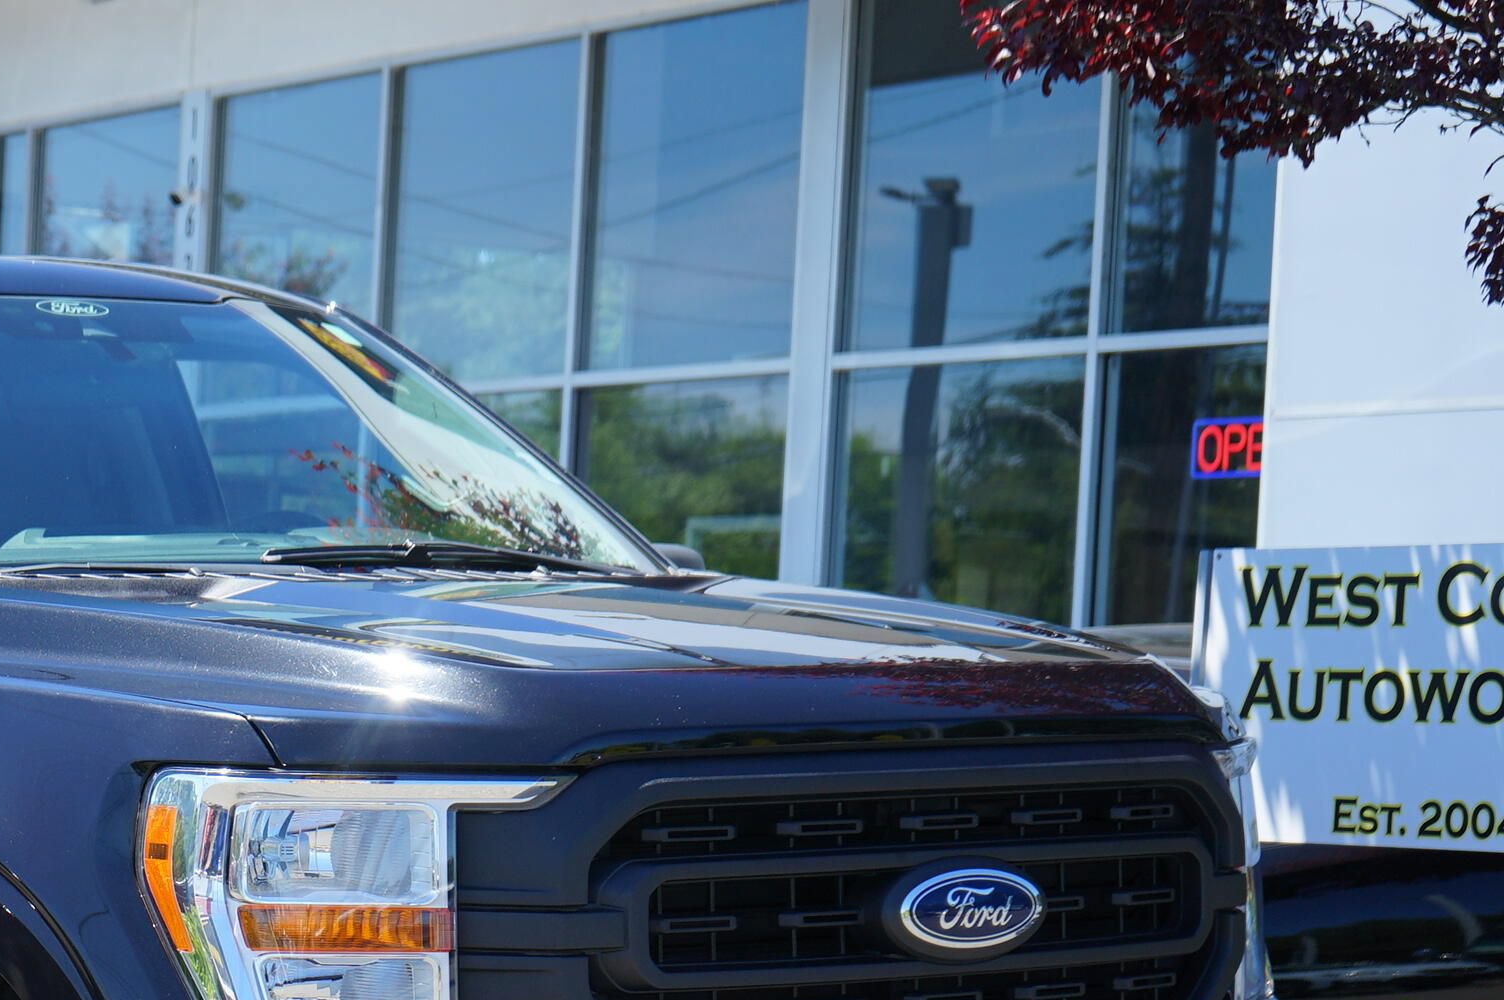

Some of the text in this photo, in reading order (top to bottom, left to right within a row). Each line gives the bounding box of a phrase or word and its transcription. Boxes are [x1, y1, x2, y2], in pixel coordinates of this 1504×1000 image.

[1239, 565, 1420, 628] WEST
[1333, 797, 1406, 836] EST.
[939, 886, 1013, 930] Ford
